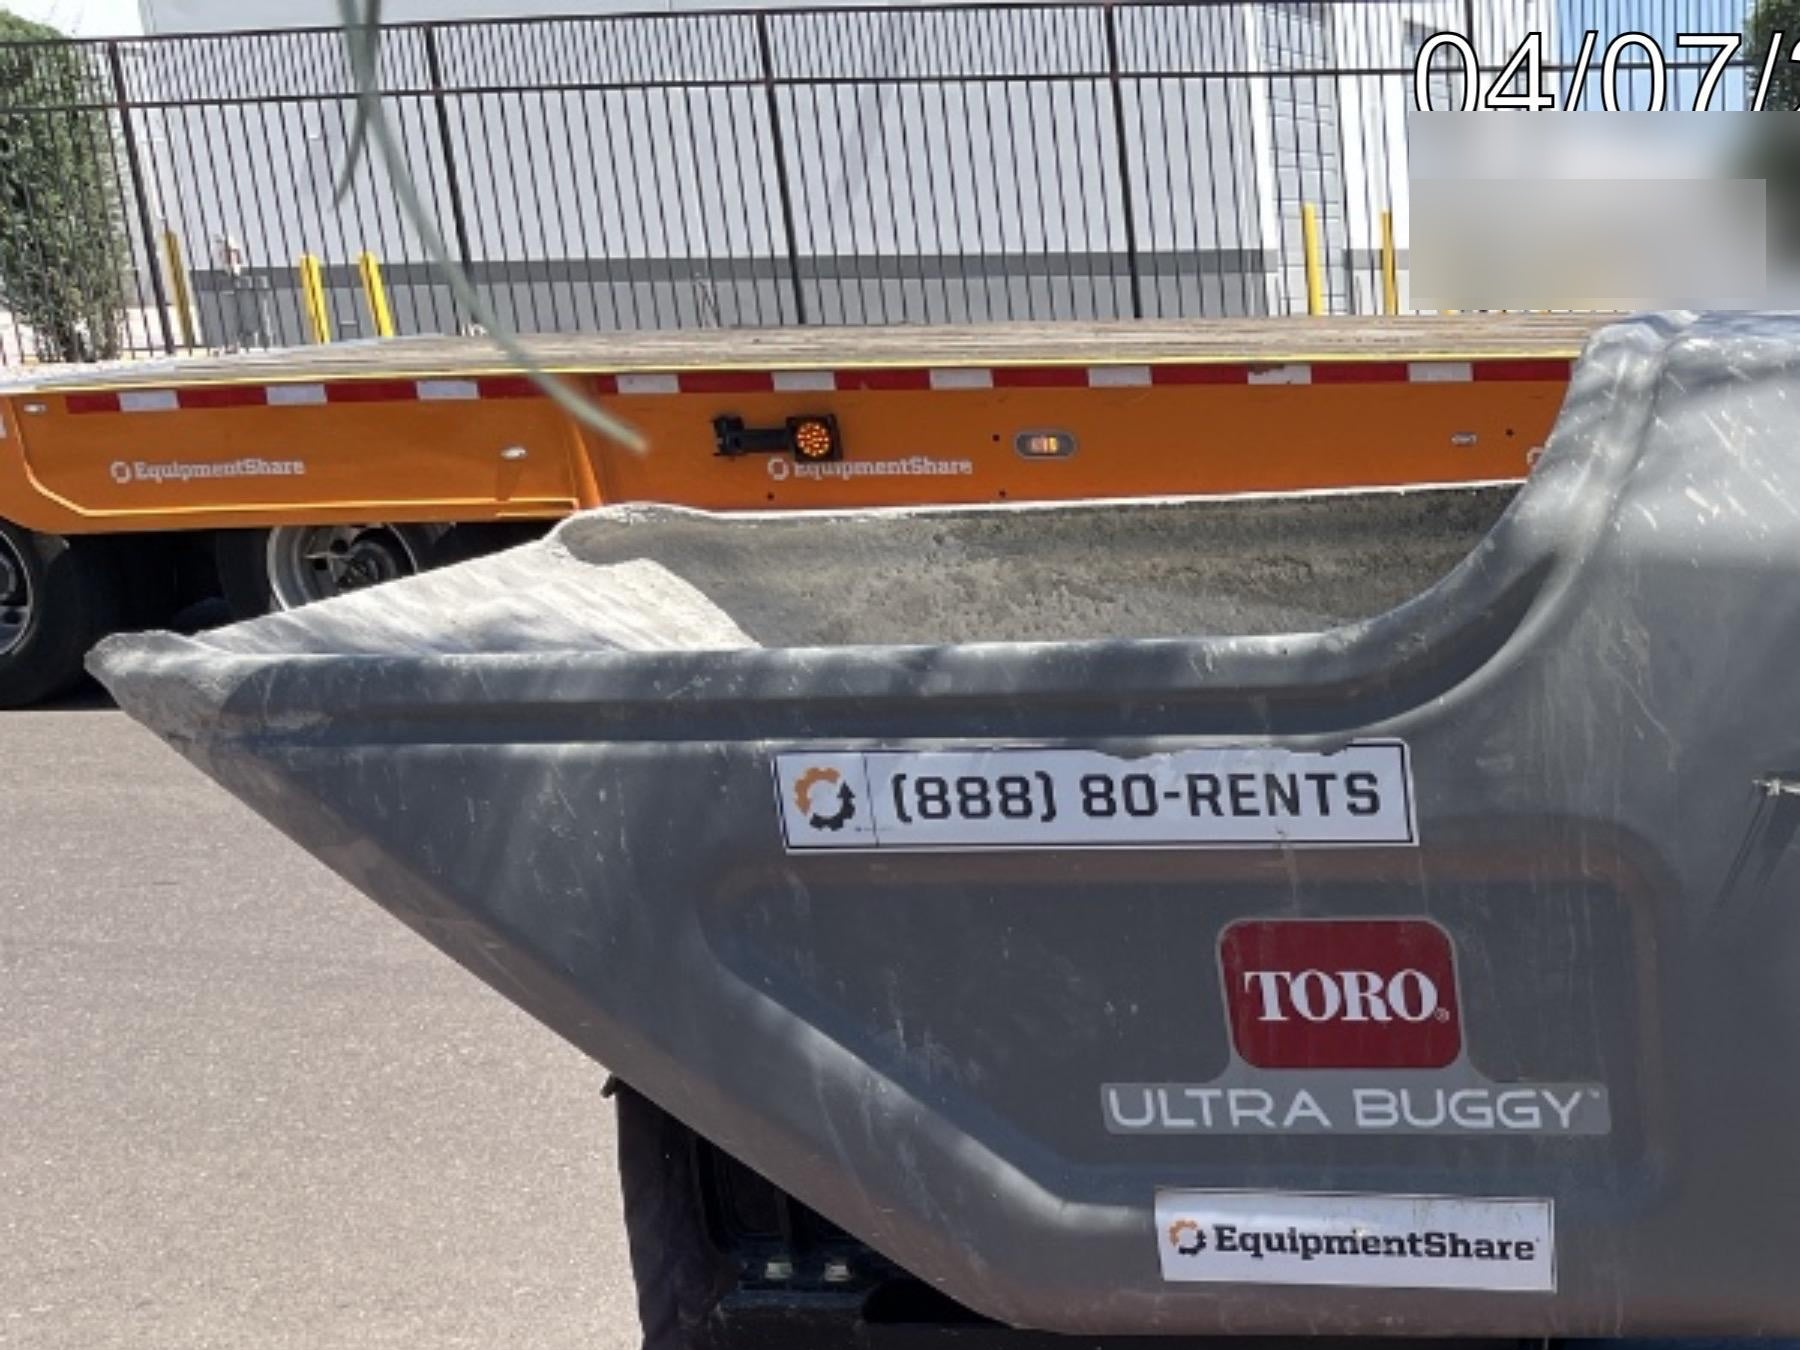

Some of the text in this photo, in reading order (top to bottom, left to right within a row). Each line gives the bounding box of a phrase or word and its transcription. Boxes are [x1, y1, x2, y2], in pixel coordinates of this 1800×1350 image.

[133, 458, 305, 484] EquipmentShare
[794, 457, 973, 481] EquipmentShare
[892, 771, 1381, 822] (888) 80-RENTS
[1109, 1088, 1332, 1128] ULTRA
[1213, 1223, 1535, 1262] EquipmentShare
